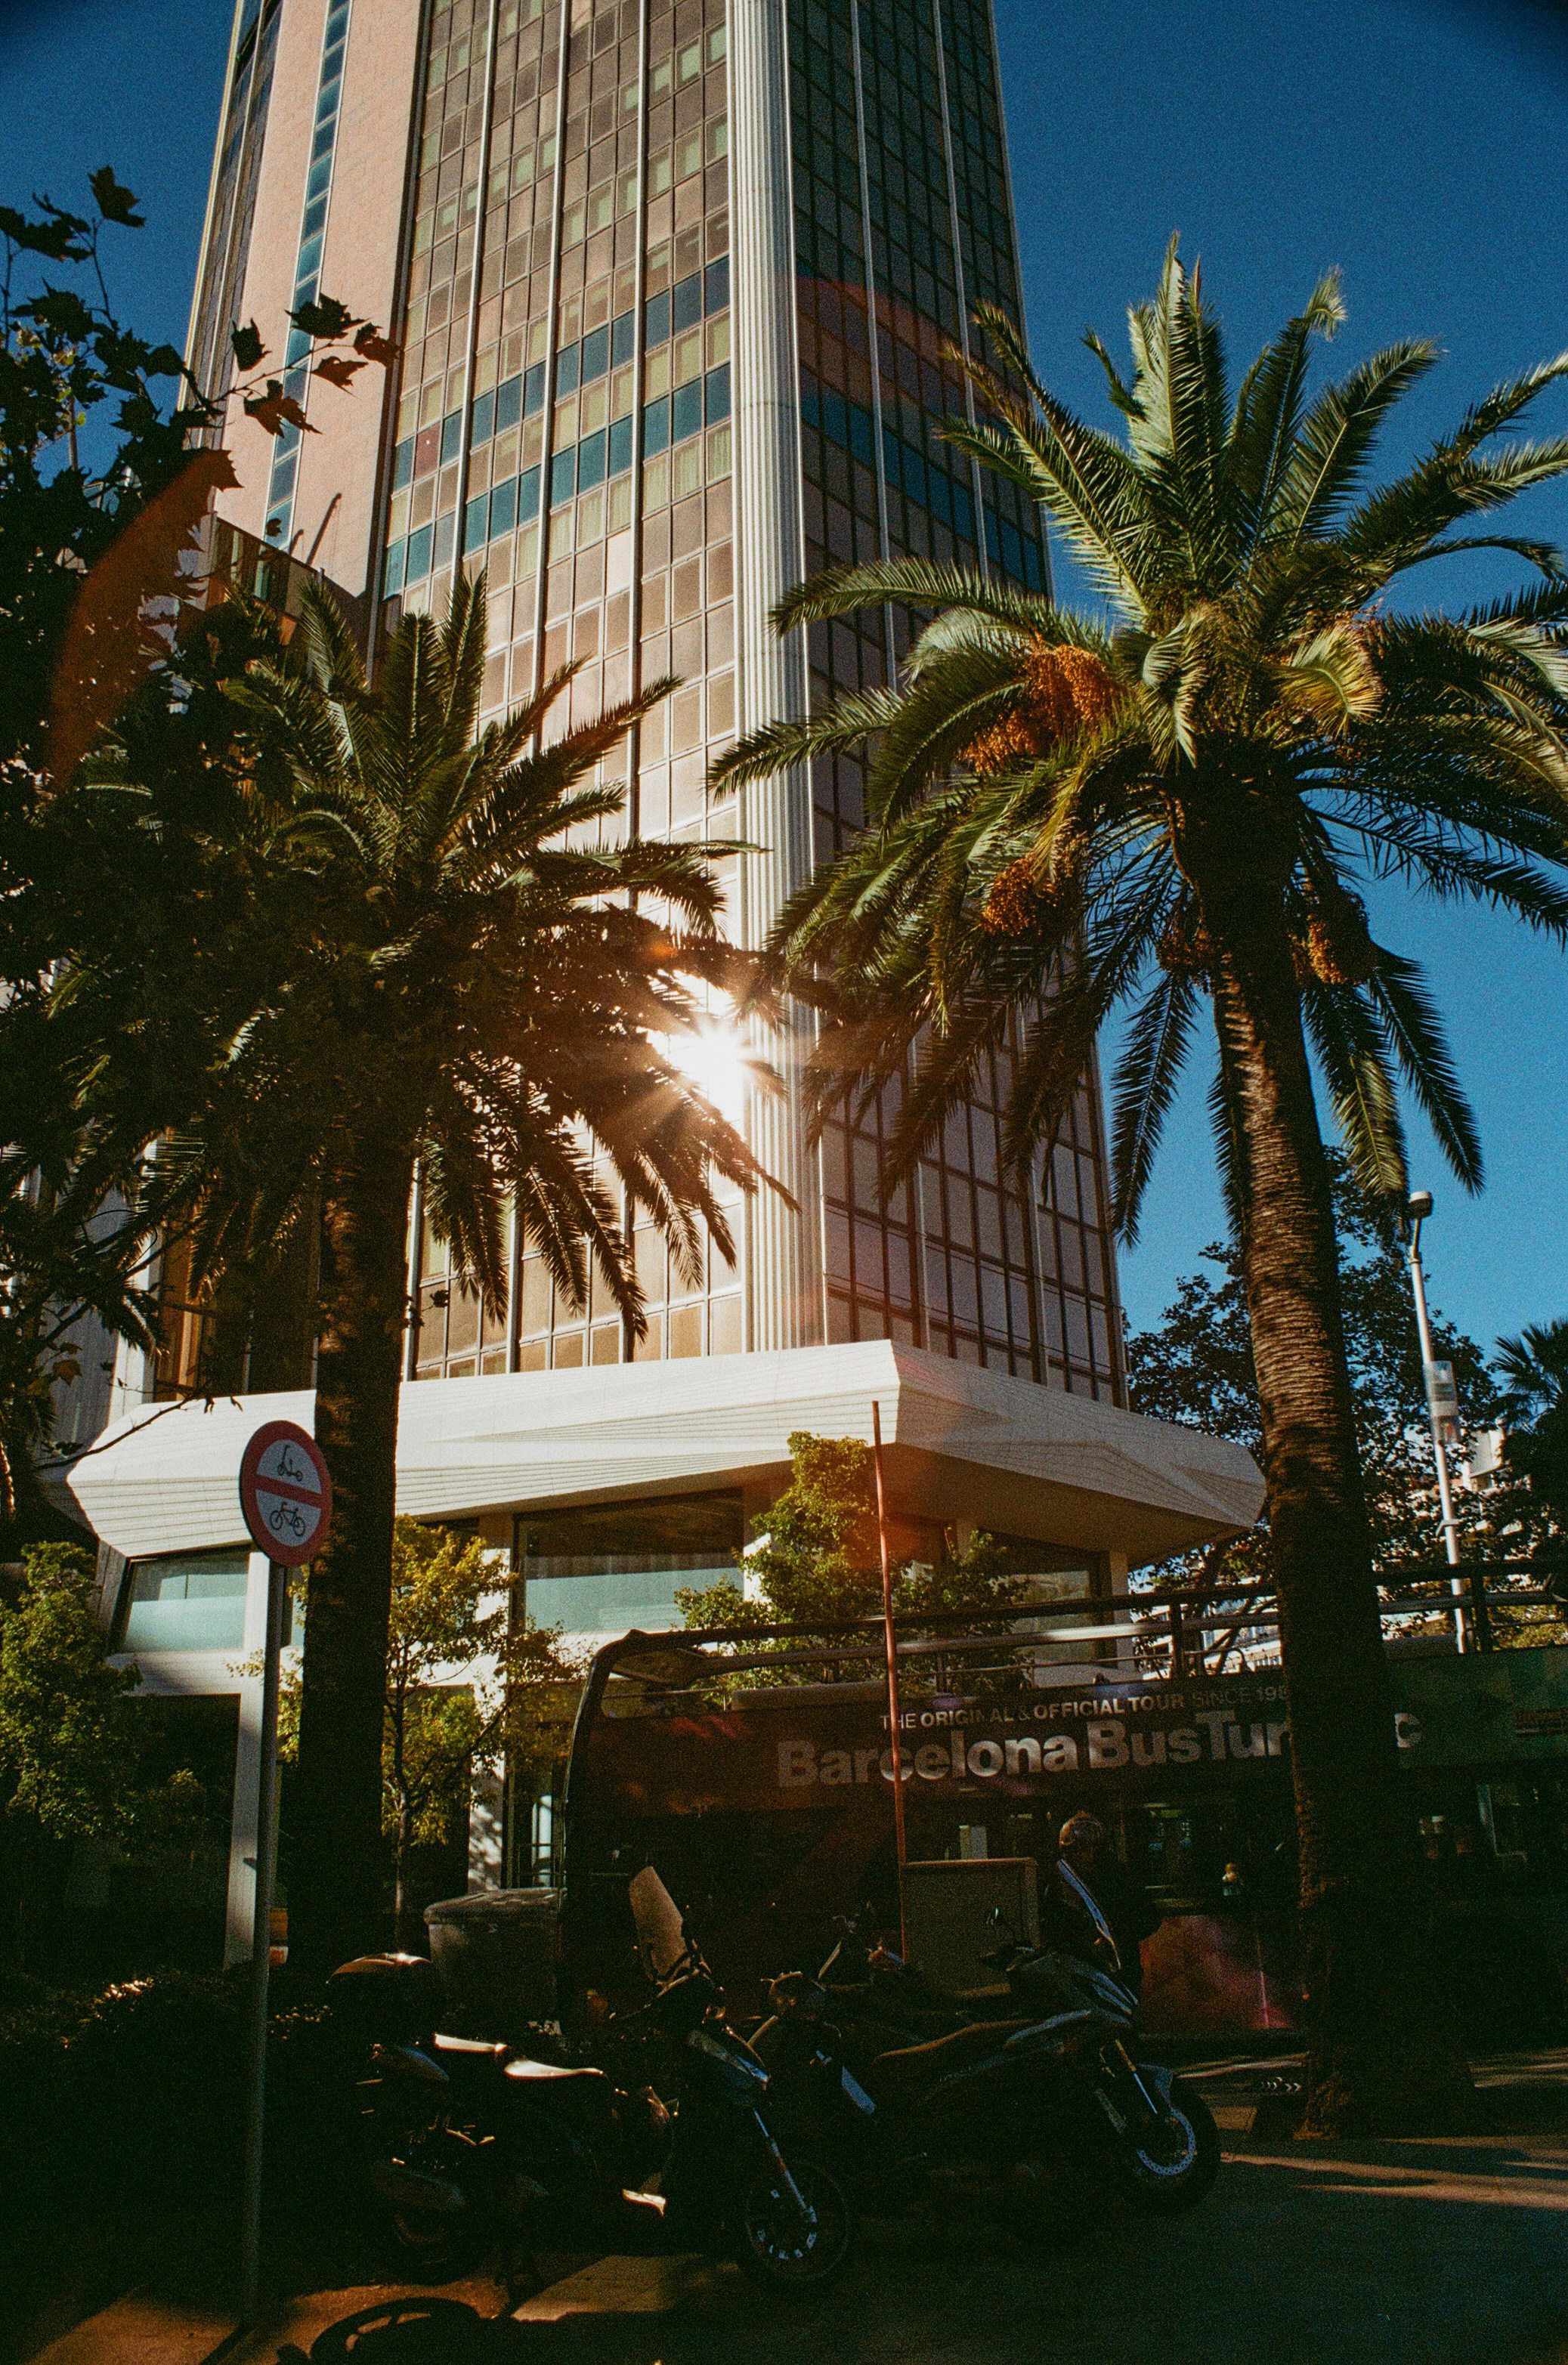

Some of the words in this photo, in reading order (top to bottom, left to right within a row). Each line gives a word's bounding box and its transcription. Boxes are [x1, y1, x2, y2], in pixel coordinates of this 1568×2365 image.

[880, 1712, 917, 1730] THE
[920, 1707, 1014, 1728] ORIGINAL
[1018, 1706, 1031, 1721] &
[1033, 1698, 1125, 1720] OFFICIAL
[1127, 1694, 1186, 1713] TOUR
[1192, 1686, 1252, 1708] SINCE
[777, 1730, 1079, 1788] Barcelona
[1087, 1710, 1421, 1770] BusTurc
